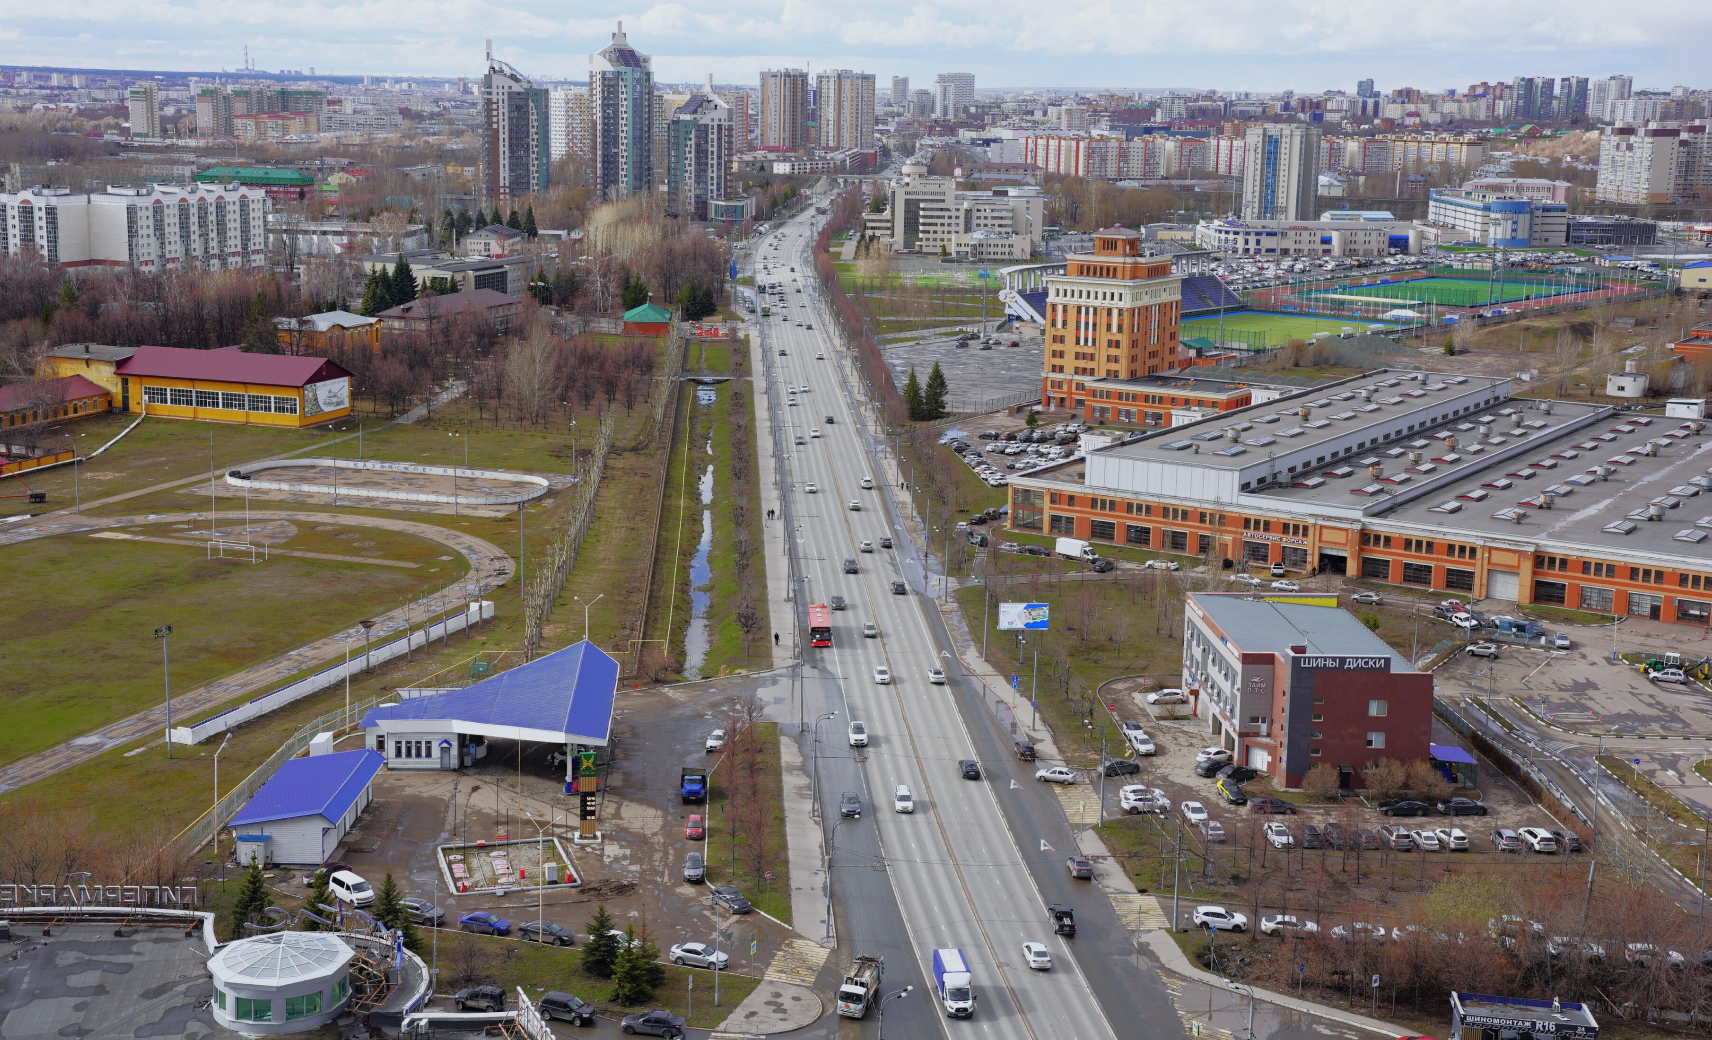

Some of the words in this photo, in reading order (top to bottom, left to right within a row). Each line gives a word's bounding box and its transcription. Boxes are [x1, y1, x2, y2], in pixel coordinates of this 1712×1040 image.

[353, 462, 427, 473] КАЗАНСКОЕ
[1243, 532, 1281, 542] АВТОСЕРВИС
[1282, 537, 1309, 546] ФОРСАЖ
[1300, 658, 1339, 668] ШИНЫ
[1344, 658, 1385, 670] ДИСКИ
[1466, 1015, 1532, 1028] ШИНОМОНТАЖ
[1535, 1021, 1557, 1032] R16
